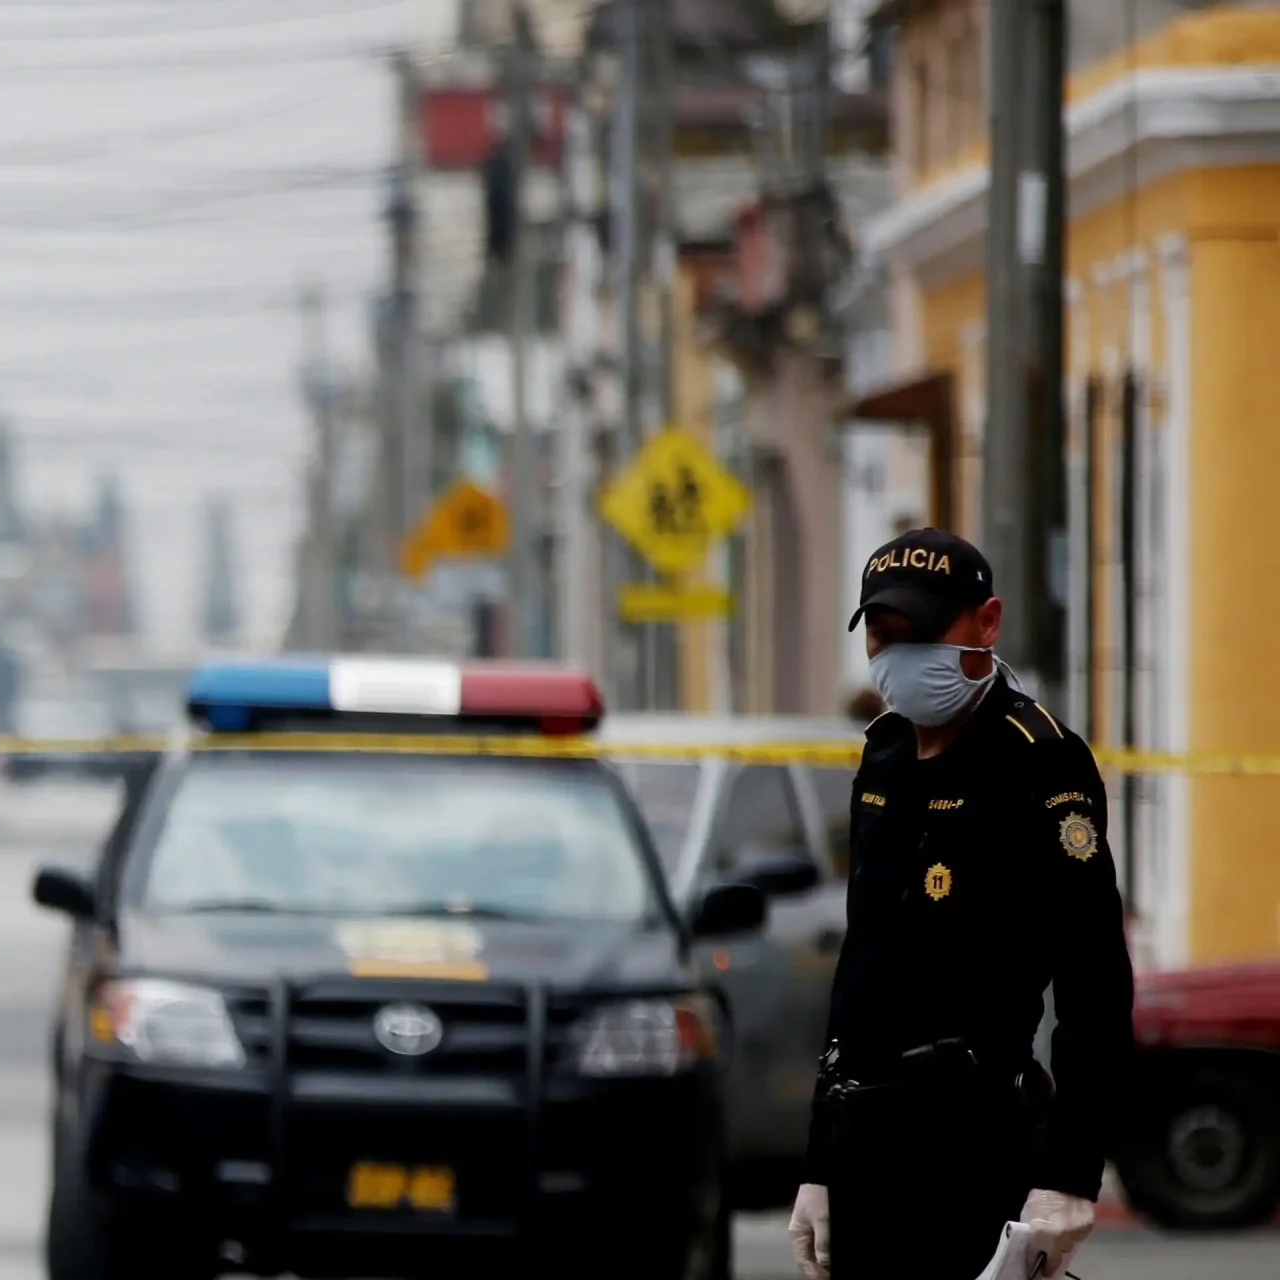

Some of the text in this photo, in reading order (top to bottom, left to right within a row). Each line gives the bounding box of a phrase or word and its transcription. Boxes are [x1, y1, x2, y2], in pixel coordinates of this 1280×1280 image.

[865, 547, 951, 579] POLICIA
[1045, 791, 1085, 808] COMISARIA
[932, 874, 944, 890] 11
